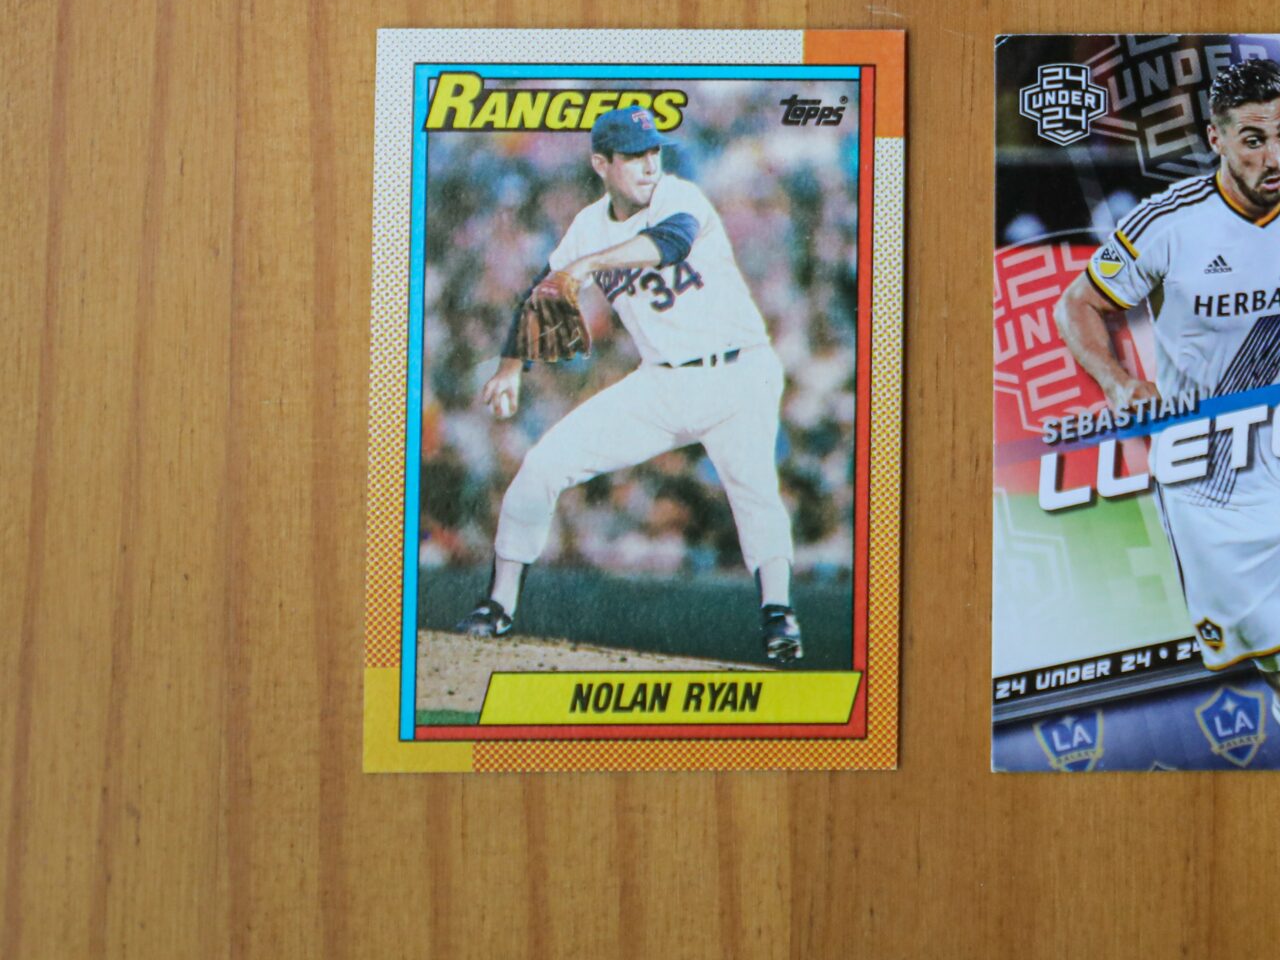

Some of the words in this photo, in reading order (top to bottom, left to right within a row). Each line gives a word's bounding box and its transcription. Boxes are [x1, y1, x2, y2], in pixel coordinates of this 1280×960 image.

[1042, 67, 1086, 90] 24
[1032, 90, 1096, 109] UNDER
[1042, 107, 1086, 130] 24
[640, 261, 704, 313] 34
[1041, 388, 1198, 445] SEBASTIAN
[996, 677, 1026, 700] 24
[1035, 658, 1111, 690] UNDER
[1120, 650, 1152, 673] 24
[569, 683, 672, 713] NOLAN
[683, 682, 763, 712] RYAN
[1052, 723, 1094, 753] LA
[1214, 709, 1254, 738] LA
